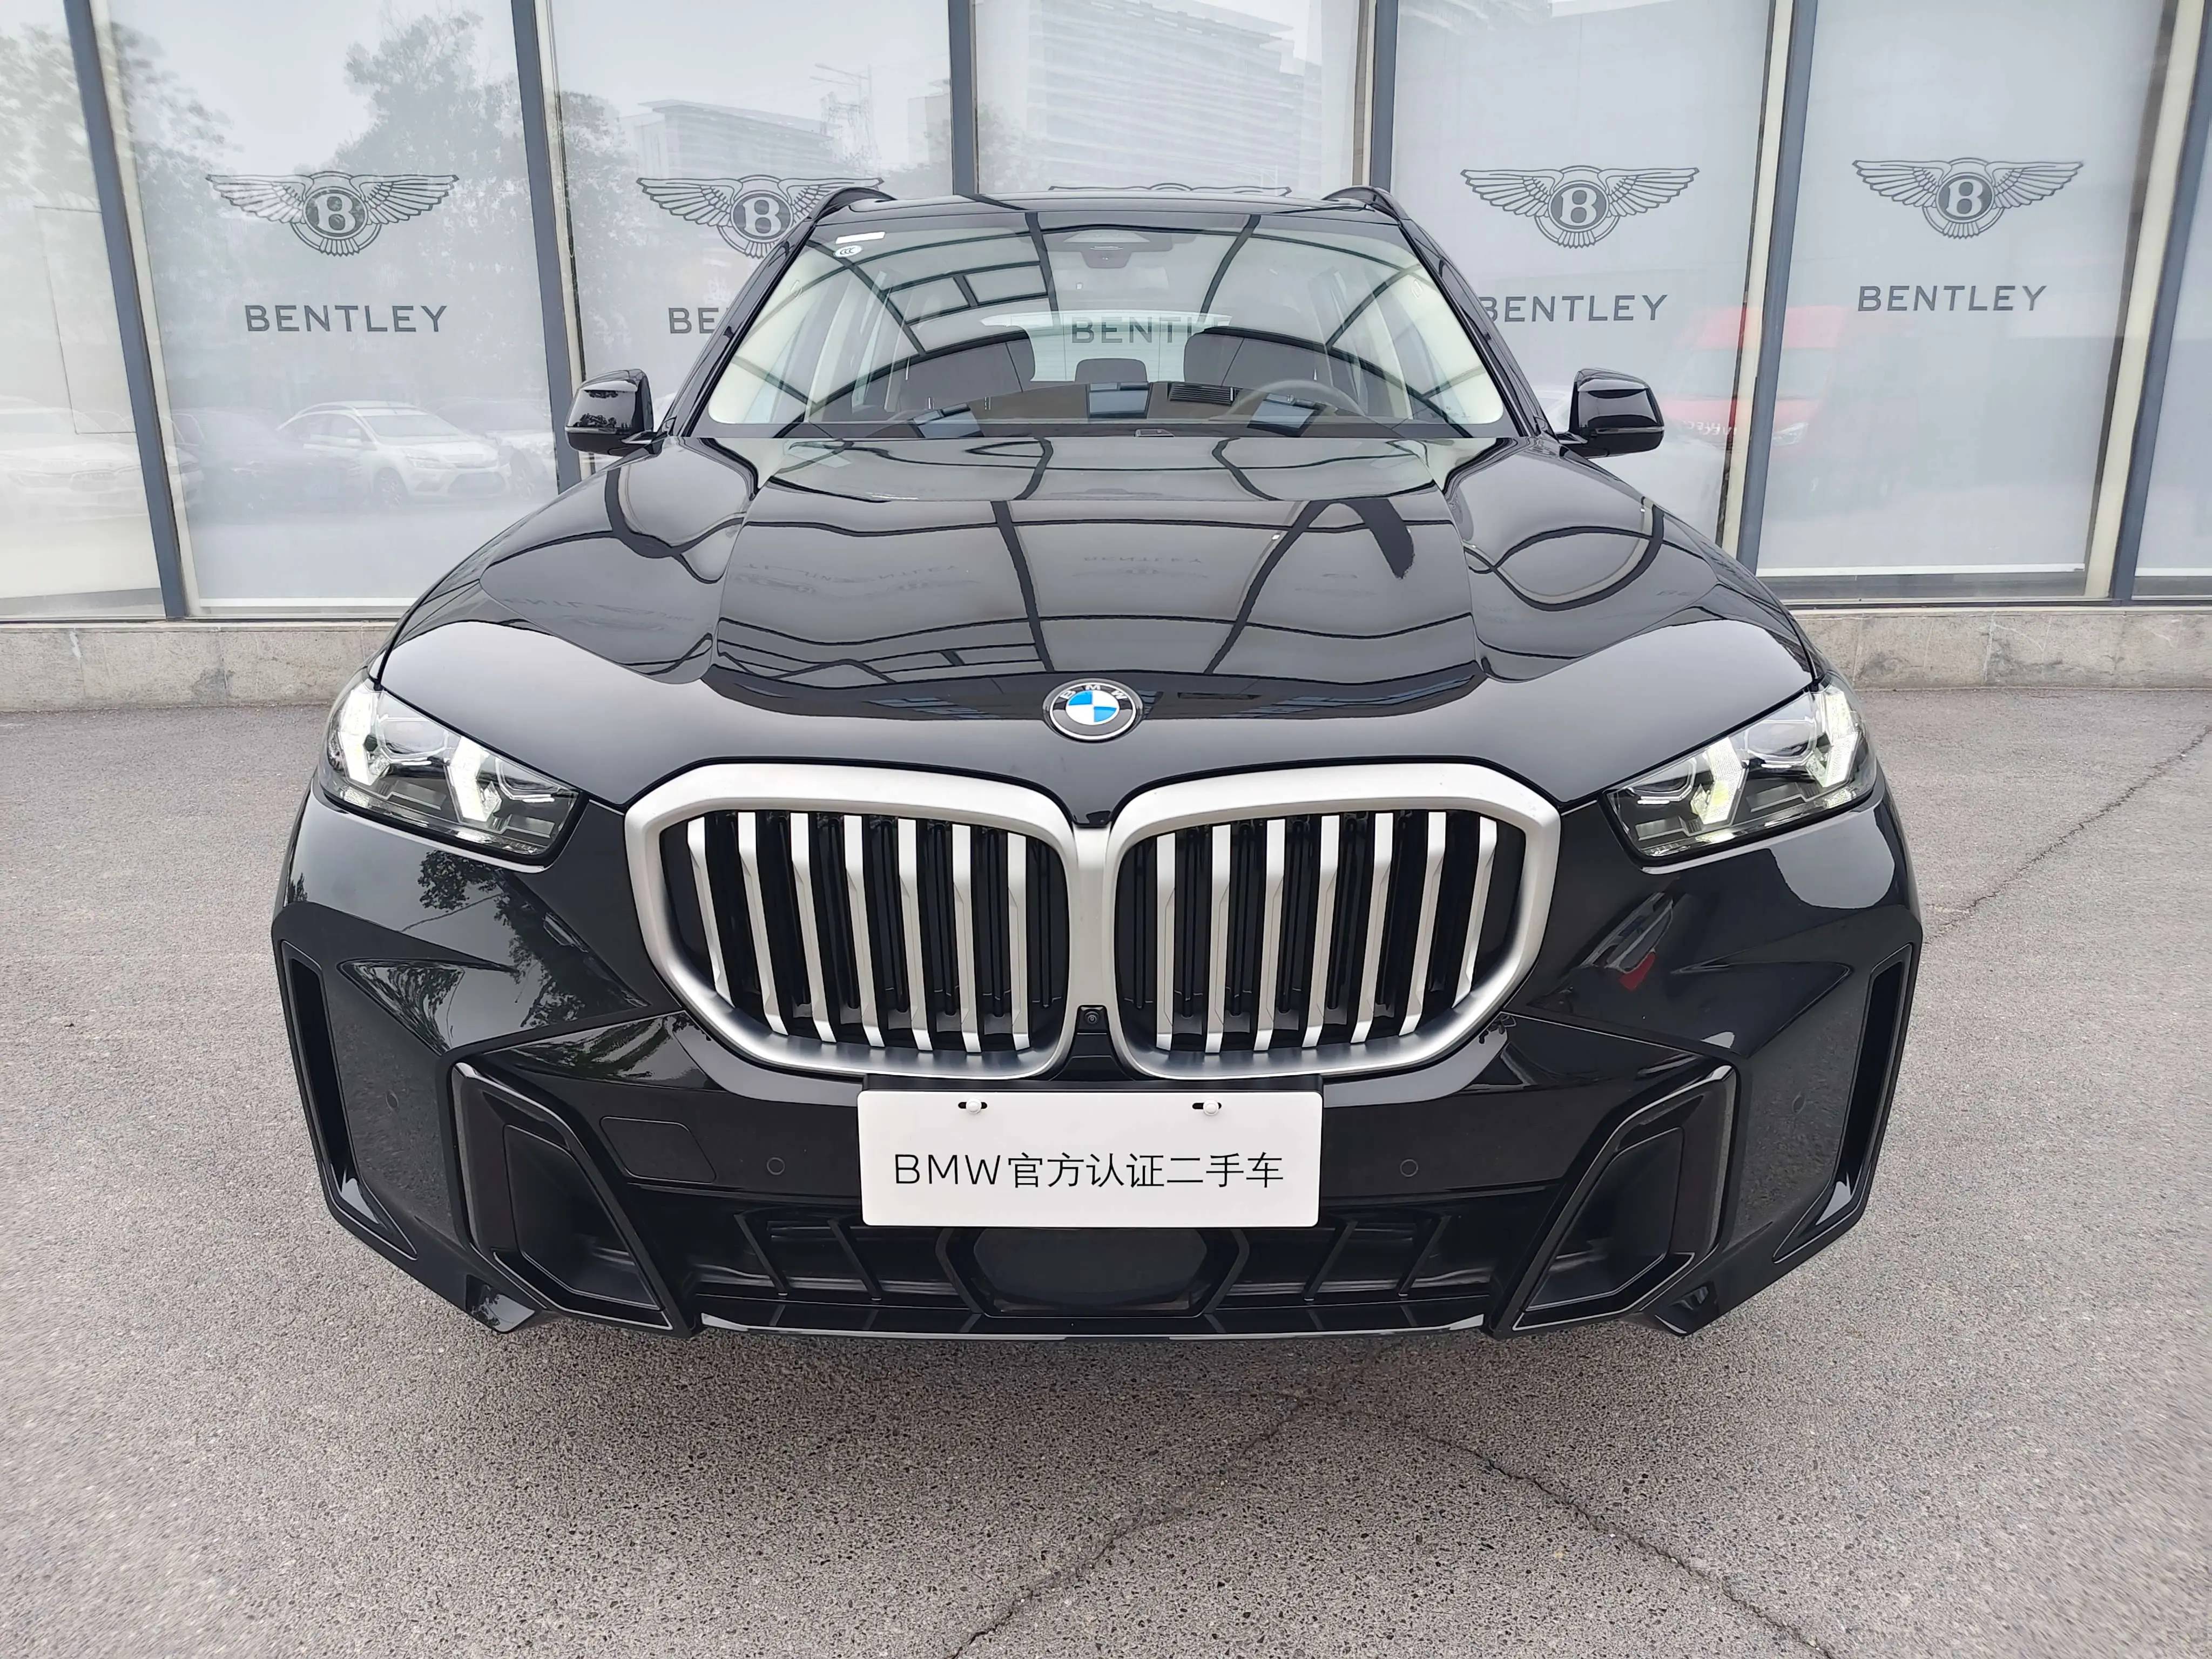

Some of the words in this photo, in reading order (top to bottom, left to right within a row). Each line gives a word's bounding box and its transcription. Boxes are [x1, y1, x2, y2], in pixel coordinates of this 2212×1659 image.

[1479, 294, 1668, 322] BENTLEY
[1857, 285, 2047, 312] BENTLEY
[245, 305, 447, 332] BENTLEY
[1060, 684, 1128, 700] BMW
[894, 1152, 1284, 1189] BMW官方认证二手车
